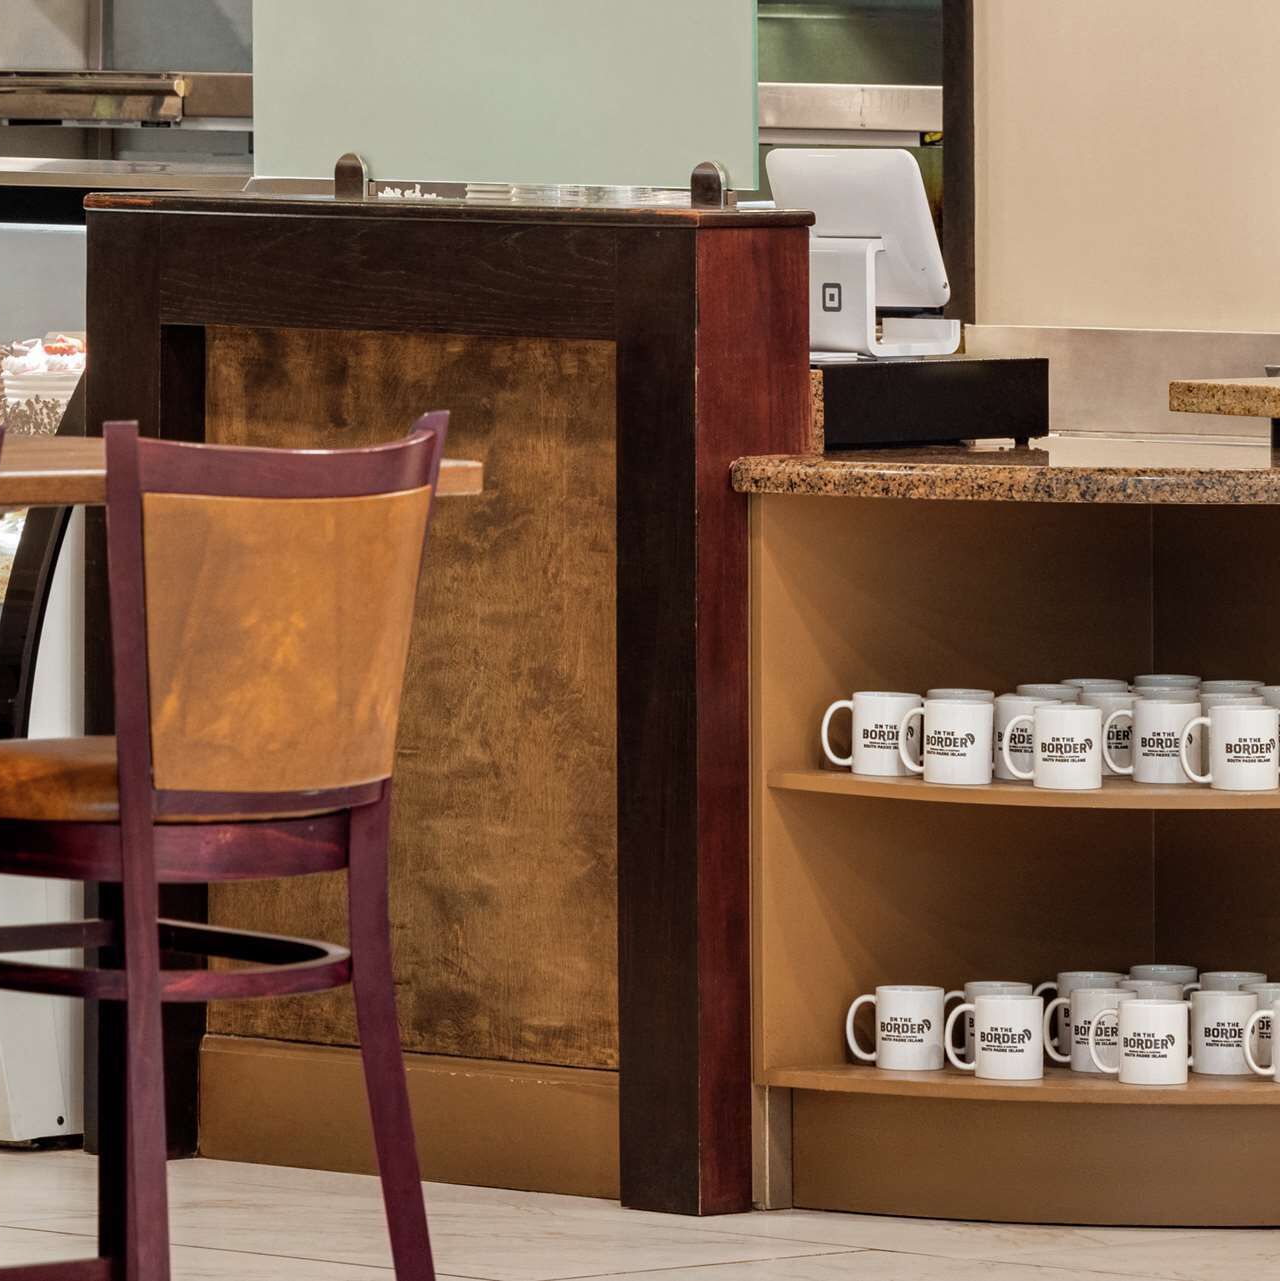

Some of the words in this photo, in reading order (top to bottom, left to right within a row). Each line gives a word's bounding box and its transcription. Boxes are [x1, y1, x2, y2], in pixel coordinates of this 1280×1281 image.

[926, 735, 968, 748] BORDER
[1141, 737, 1180, 749] BORDE
[1041, 742, 1087, 755] BORDER
[1225, 743, 1271, 755] BORDER
[880, 1022, 925, 1034] BORDER
[1204, 1027, 1243, 1039] BORDE
[980, 1032, 1026, 1044] BORDER
[1123, 1037, 1168, 1050] BORDER
